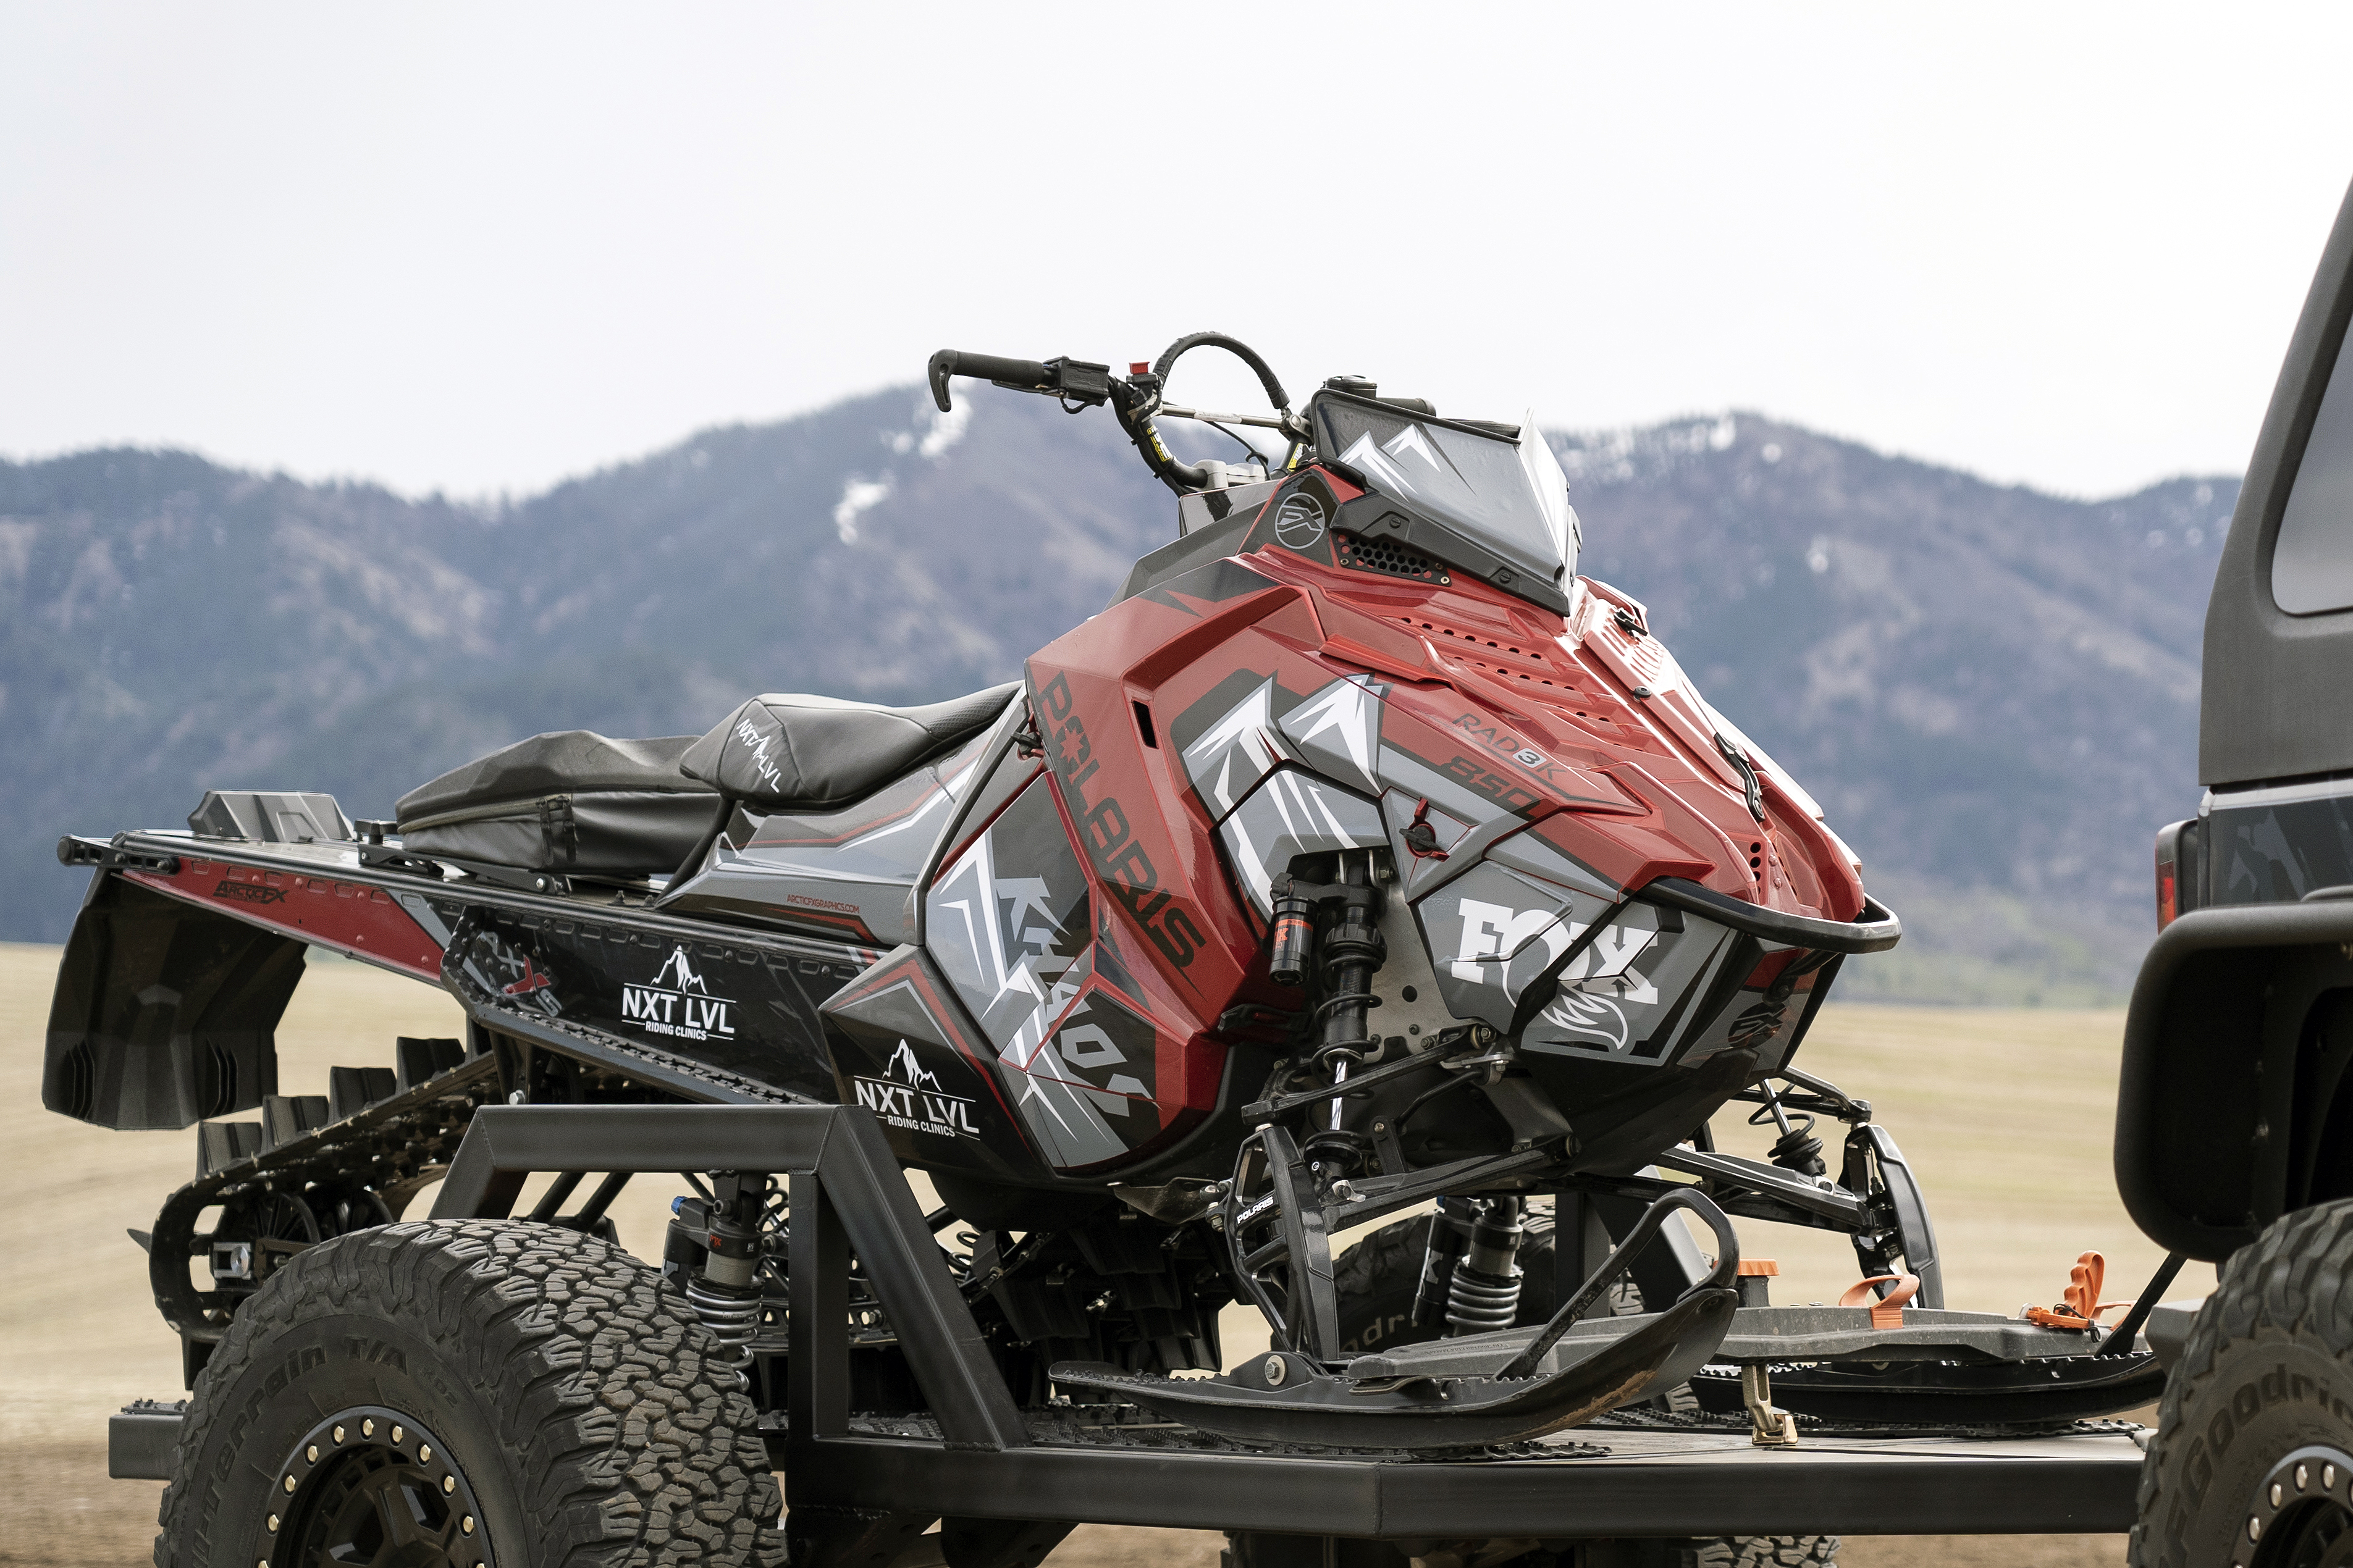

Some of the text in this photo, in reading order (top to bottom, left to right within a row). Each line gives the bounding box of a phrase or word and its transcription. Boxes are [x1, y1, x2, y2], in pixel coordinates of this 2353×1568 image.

[757, 755, 781, 793] LVL
[1038, 670, 1207, 968] POLARIS
[1452, 898, 1659, 1005] FOX
[622, 988, 735, 1034] NXT LVL
[646, 1020, 707, 1041] RIDING CLINICS
[854, 1080, 980, 1134] NXT LVL
[887, 1115, 955, 1137] RIDING CLINICS
[1237, 1196, 1274, 1225] POLARIS
